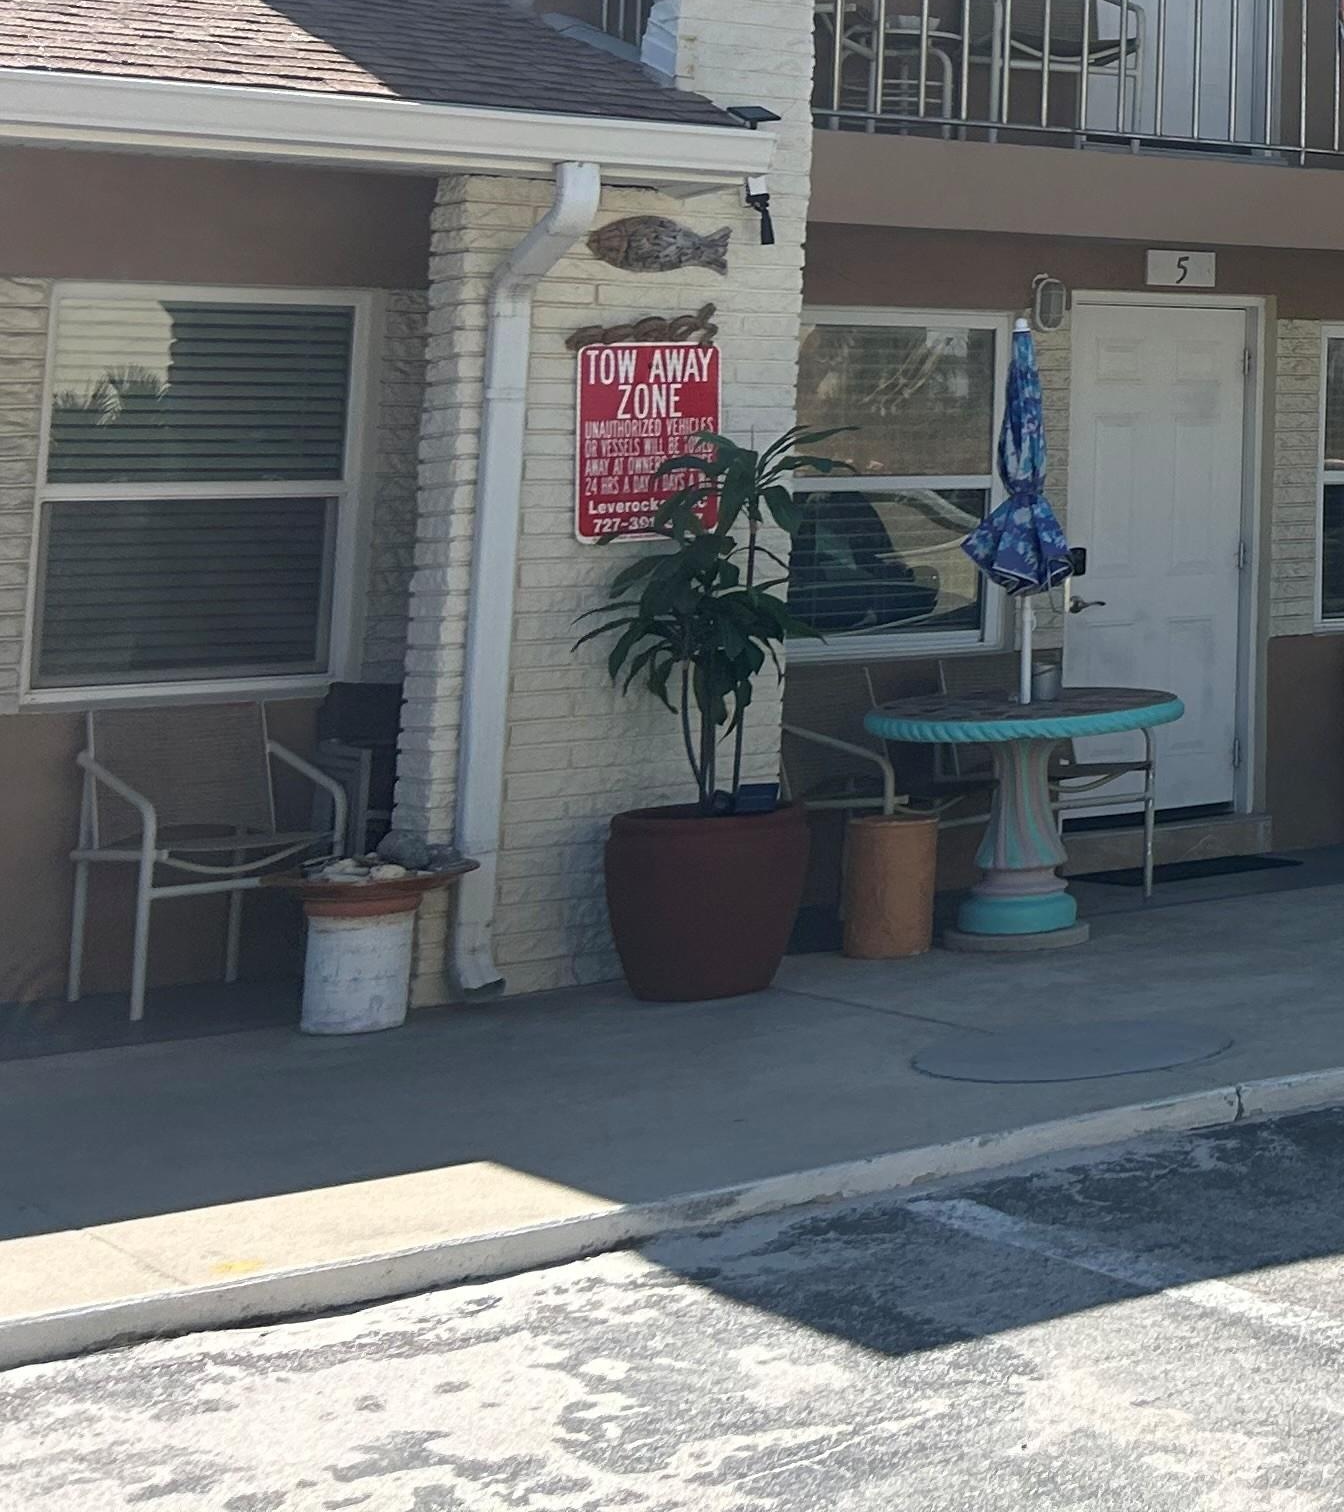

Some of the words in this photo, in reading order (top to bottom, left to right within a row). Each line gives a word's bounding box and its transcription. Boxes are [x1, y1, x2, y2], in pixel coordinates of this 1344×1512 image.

[1175, 256, 1190, 284] 5
[586, 349, 637, 385] TOW
[648, 348, 713, 383] AWAY
[616, 383, 682, 419] ZONE
[585, 418, 662, 439] UNAUTHORIZED
[585, 439, 598, 458] OR
[600, 438, 640, 457] VESSELS
[643, 437, 665, 455] WILL
[668, 436, 680, 454] BE
[585, 456, 610, 477] AWAY
[612, 456, 625, 476] AT
[585, 476, 598, 495] 24
[601, 475, 619, 494] HRS
[623, 475, 631, 493] A
[633, 474, 650, 493] DAY
